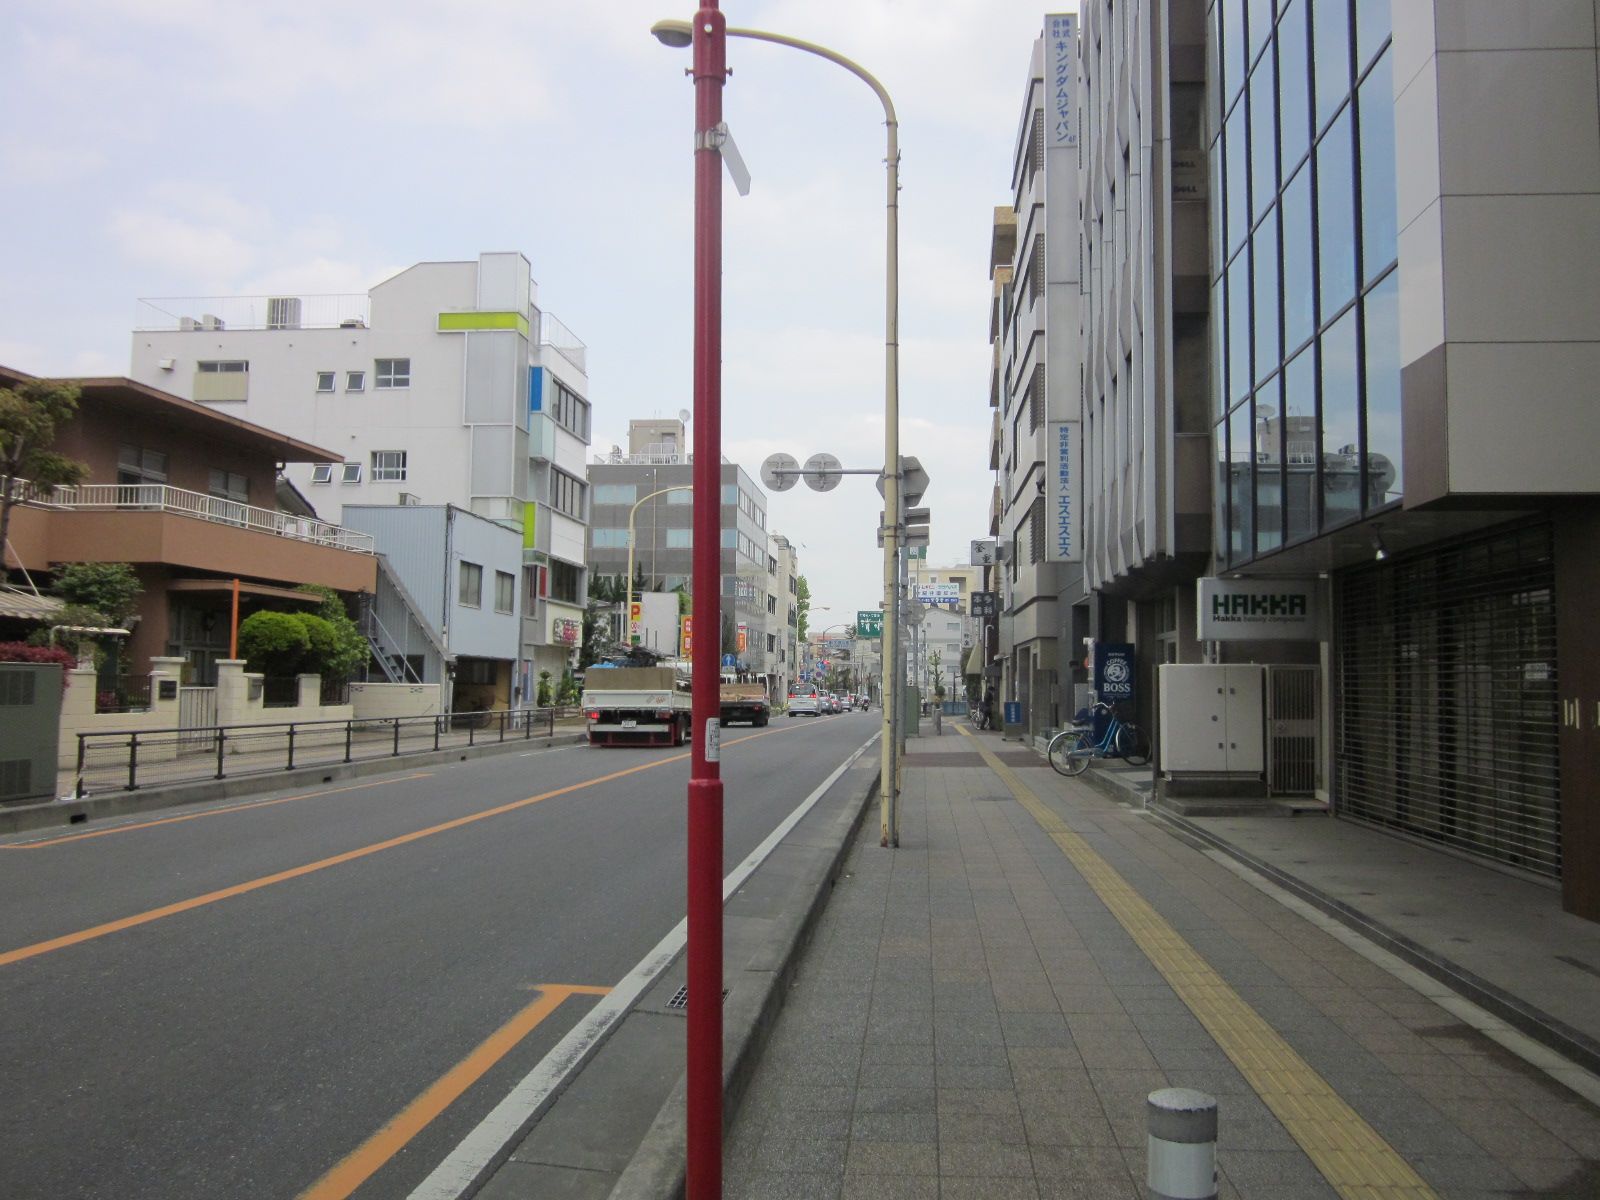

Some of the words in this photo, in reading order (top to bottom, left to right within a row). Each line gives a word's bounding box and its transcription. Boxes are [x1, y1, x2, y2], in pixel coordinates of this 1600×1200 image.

[1055, 40, 1069, 142] キングダムジャパン
[1058, 495, 1070, 557] エスエスエス
[1212, 594, 1306, 615] HAKKA
[1106, 657, 1127, 666] COFFEE
[1103, 683, 1131, 693] BOSS
